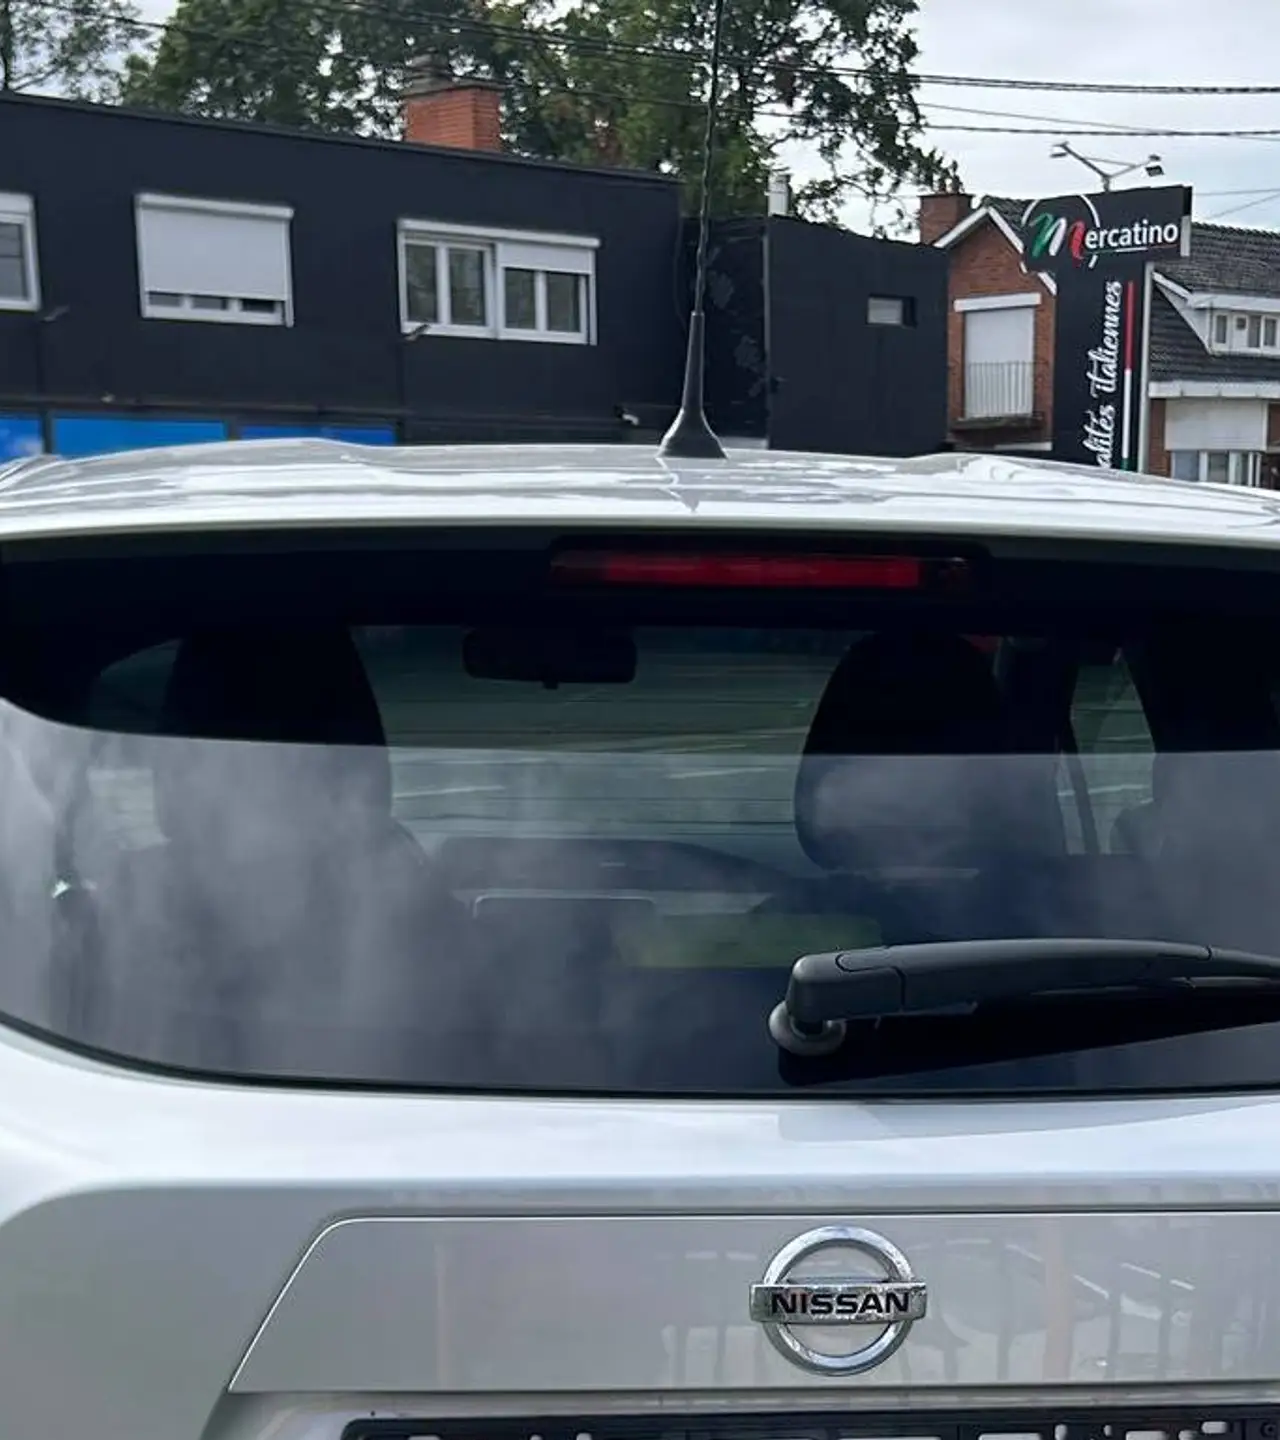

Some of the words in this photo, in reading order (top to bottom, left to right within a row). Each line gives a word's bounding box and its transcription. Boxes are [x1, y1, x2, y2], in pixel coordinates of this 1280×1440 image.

[1029, 212, 1179, 268] Mercatino
[1086, 280, 1123, 398] italiennes
[1082, 405, 1116, 469] alités
[770, 1291, 910, 1315] NISSAN
